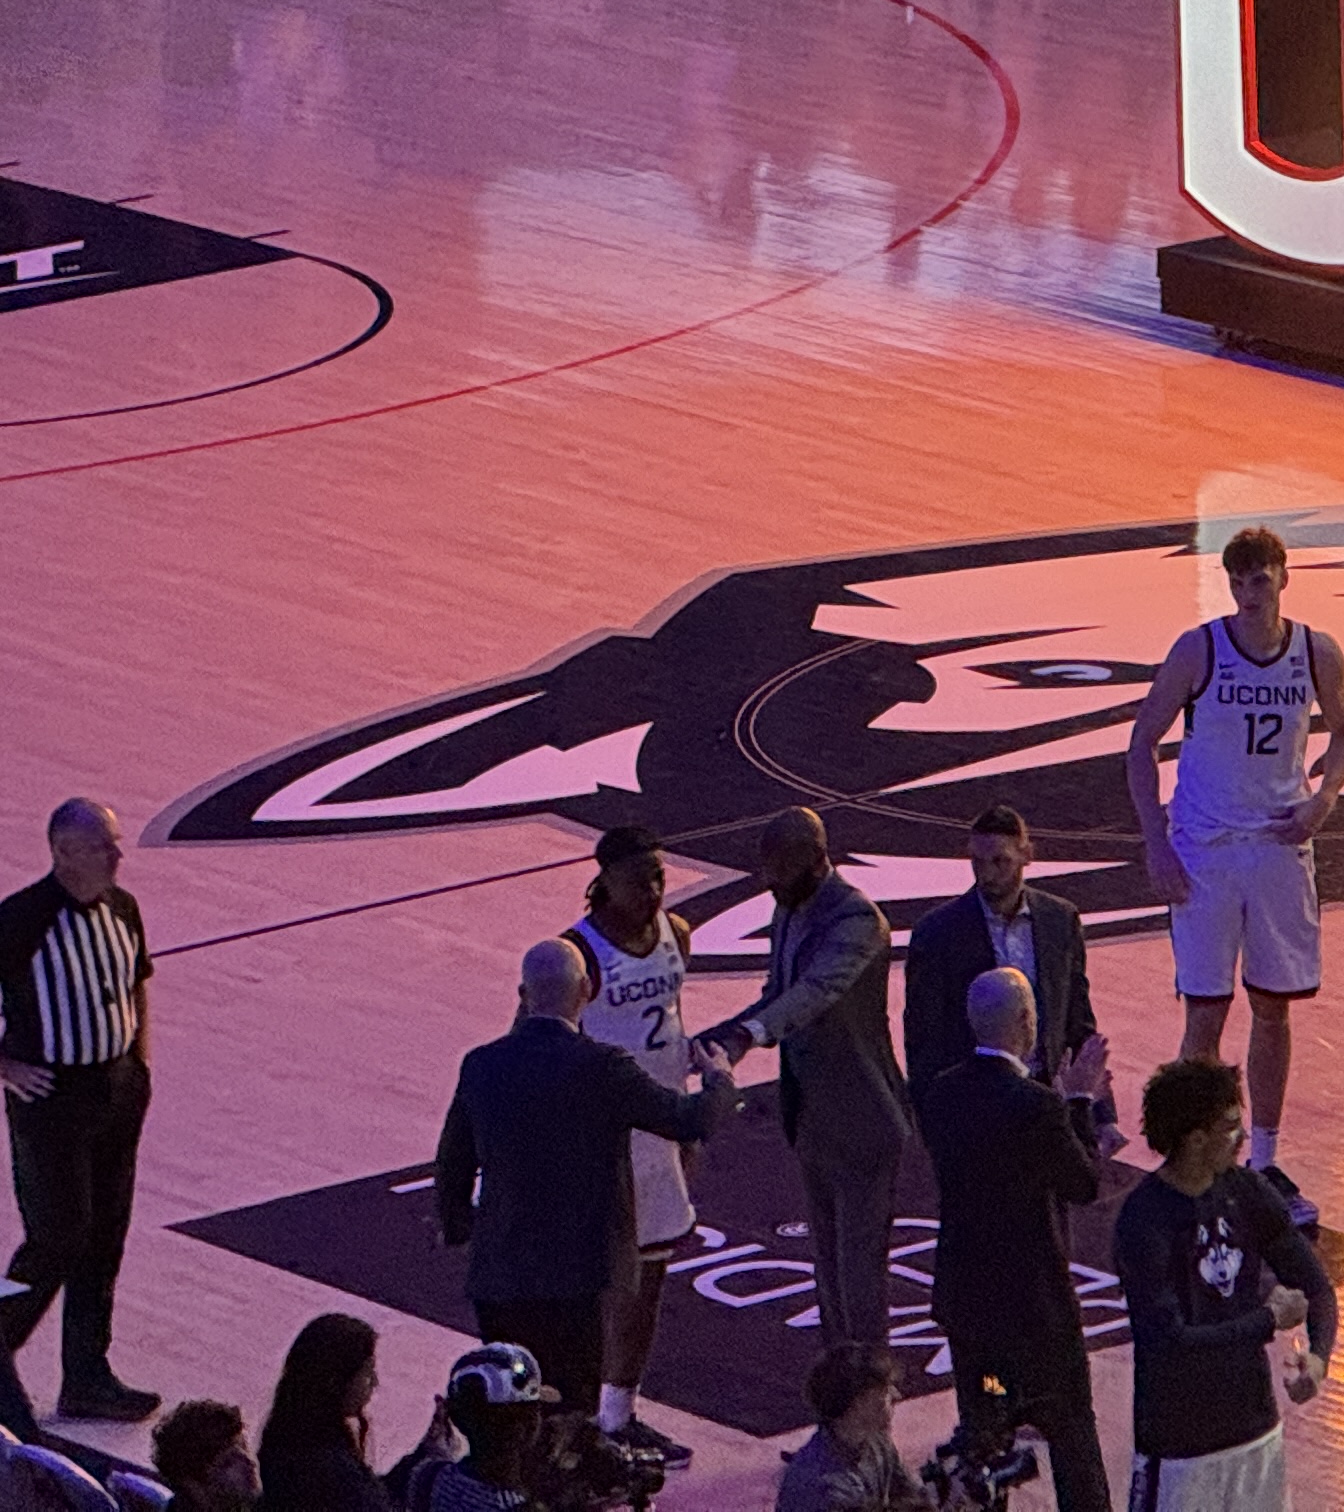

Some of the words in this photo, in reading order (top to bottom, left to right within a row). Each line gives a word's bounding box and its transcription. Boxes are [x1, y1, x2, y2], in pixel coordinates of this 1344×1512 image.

[1216, 683, 1307, 707] UCONN
[1243, 713, 1282, 755] 12
[641, 1005, 667, 1051] 2
